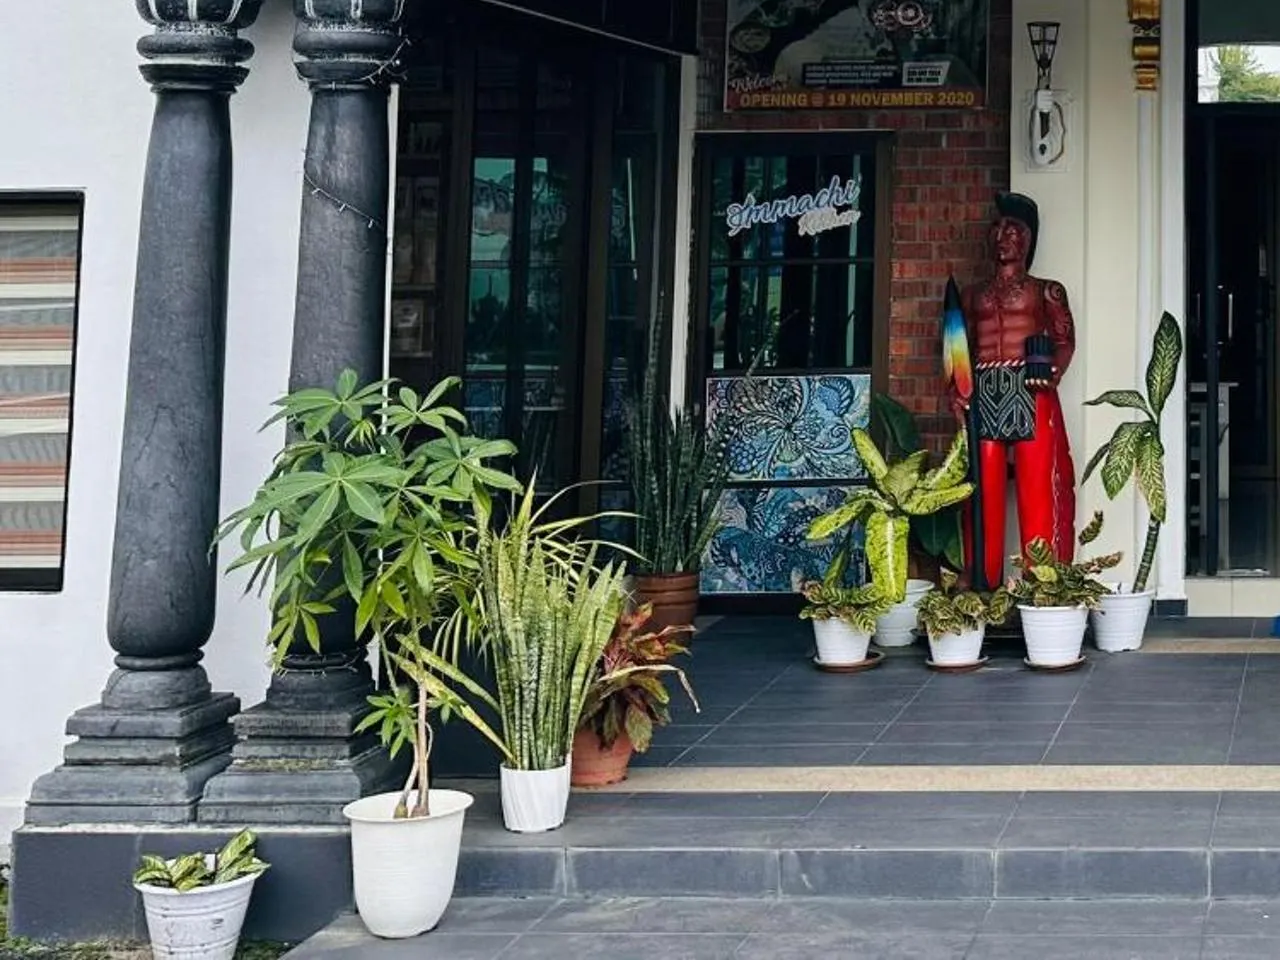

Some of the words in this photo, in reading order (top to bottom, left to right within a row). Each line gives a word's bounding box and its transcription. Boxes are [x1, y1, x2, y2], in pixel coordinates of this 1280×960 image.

[739, 92, 808, 108] OPENING
[828, 92, 847, 107] 19
[850, 91, 934, 107] NOVEMBER
[937, 90, 975, 106] 2020
